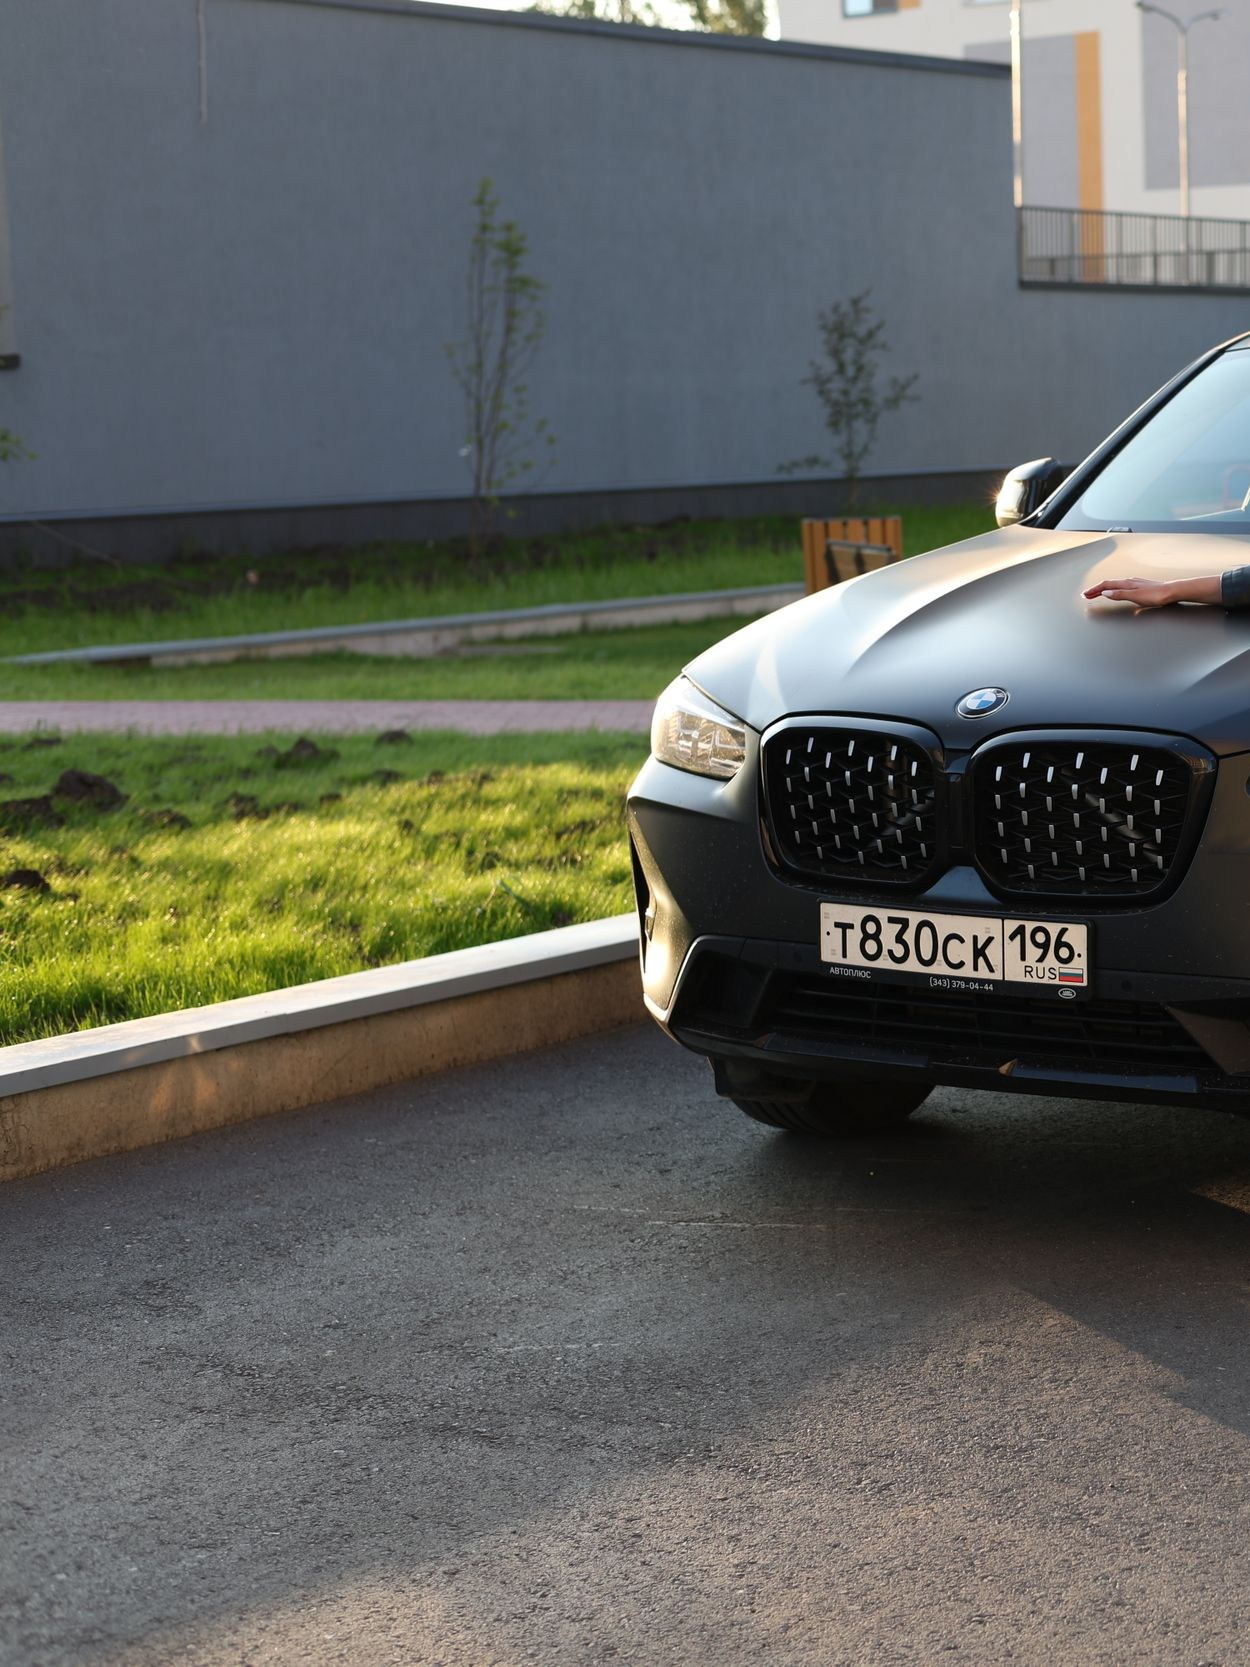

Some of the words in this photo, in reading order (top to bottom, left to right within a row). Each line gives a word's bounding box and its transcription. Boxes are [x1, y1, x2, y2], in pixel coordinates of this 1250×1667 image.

[1008, 923, 1075, 964] 196
[829, 966, 872, 979] АВТОПЛЮС
[1023, 965, 1057, 980] RUS
[929, 976, 950, 989] (343)
[951, 979, 994, 991] 379-04-44
